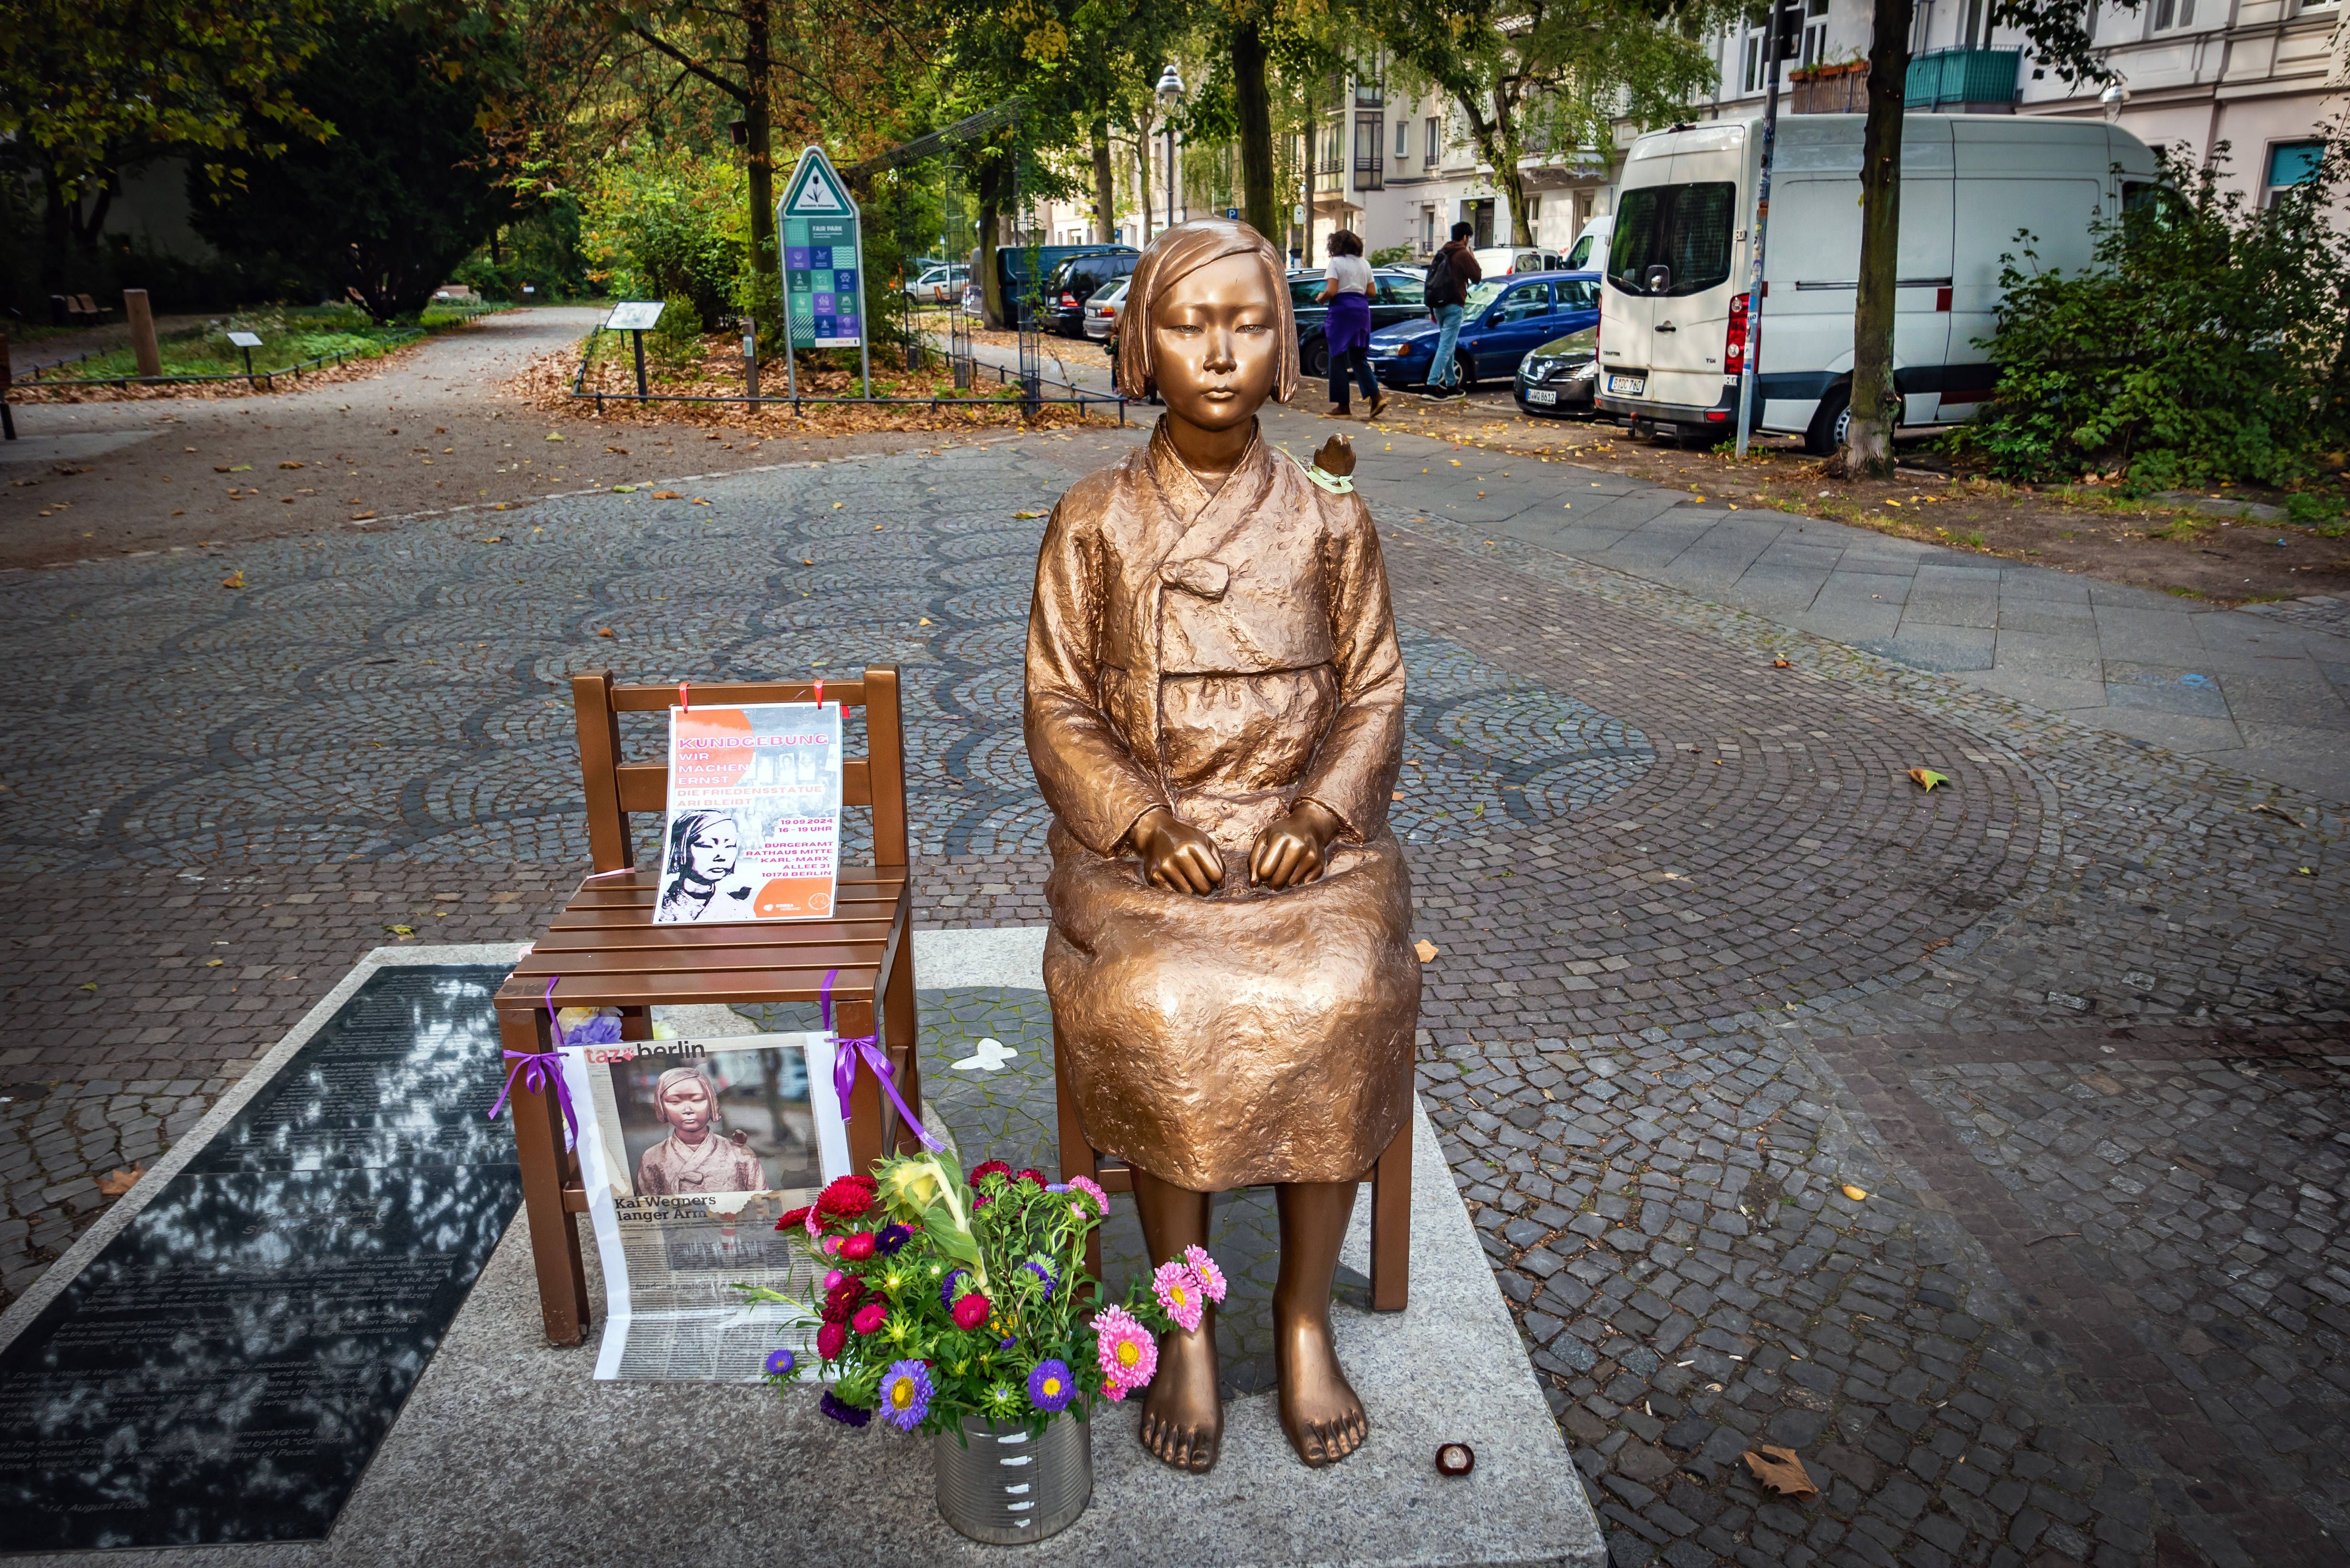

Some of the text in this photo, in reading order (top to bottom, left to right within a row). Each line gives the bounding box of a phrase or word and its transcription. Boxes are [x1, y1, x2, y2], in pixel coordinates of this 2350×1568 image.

[1629, 380, 1641, 391] 760
[1541, 392, 1555, 402] 8612
[679, 734, 829, 749] KUNDGEBUNG
[679, 753, 710, 761] WIR
[679, 763, 750, 773] MACHEN
[678, 776, 730, 785] ERNST
[703, 786, 822, 795] FRIEDENSSTATUE
[704, 798, 752, 806] BLEIBT
[584, 1041, 706, 1064] taz berlin
[614, 1195, 716, 1209] Kai Wegners
[616, 1209, 708, 1223] langer Arm
[310, 1270, 387, 1279] Friedensstatue
[56, 1369, 91, 1377] World
[254, 1361, 311, 1369] abducted
[263, 1399, 288, 1407] who
[13, 1440, 35, 1448] The
[37, 1438, 82, 1447] Korean
[35, 1449, 79, 1457] Sexual
[253, 1440, 269, 1448] by
[269, 1438, 290, 1446] AG
[36, 1460, 88, 1468] Verband
[276, 1448, 318, 1457] Peace.
[67, 1503, 115, 1513] August
